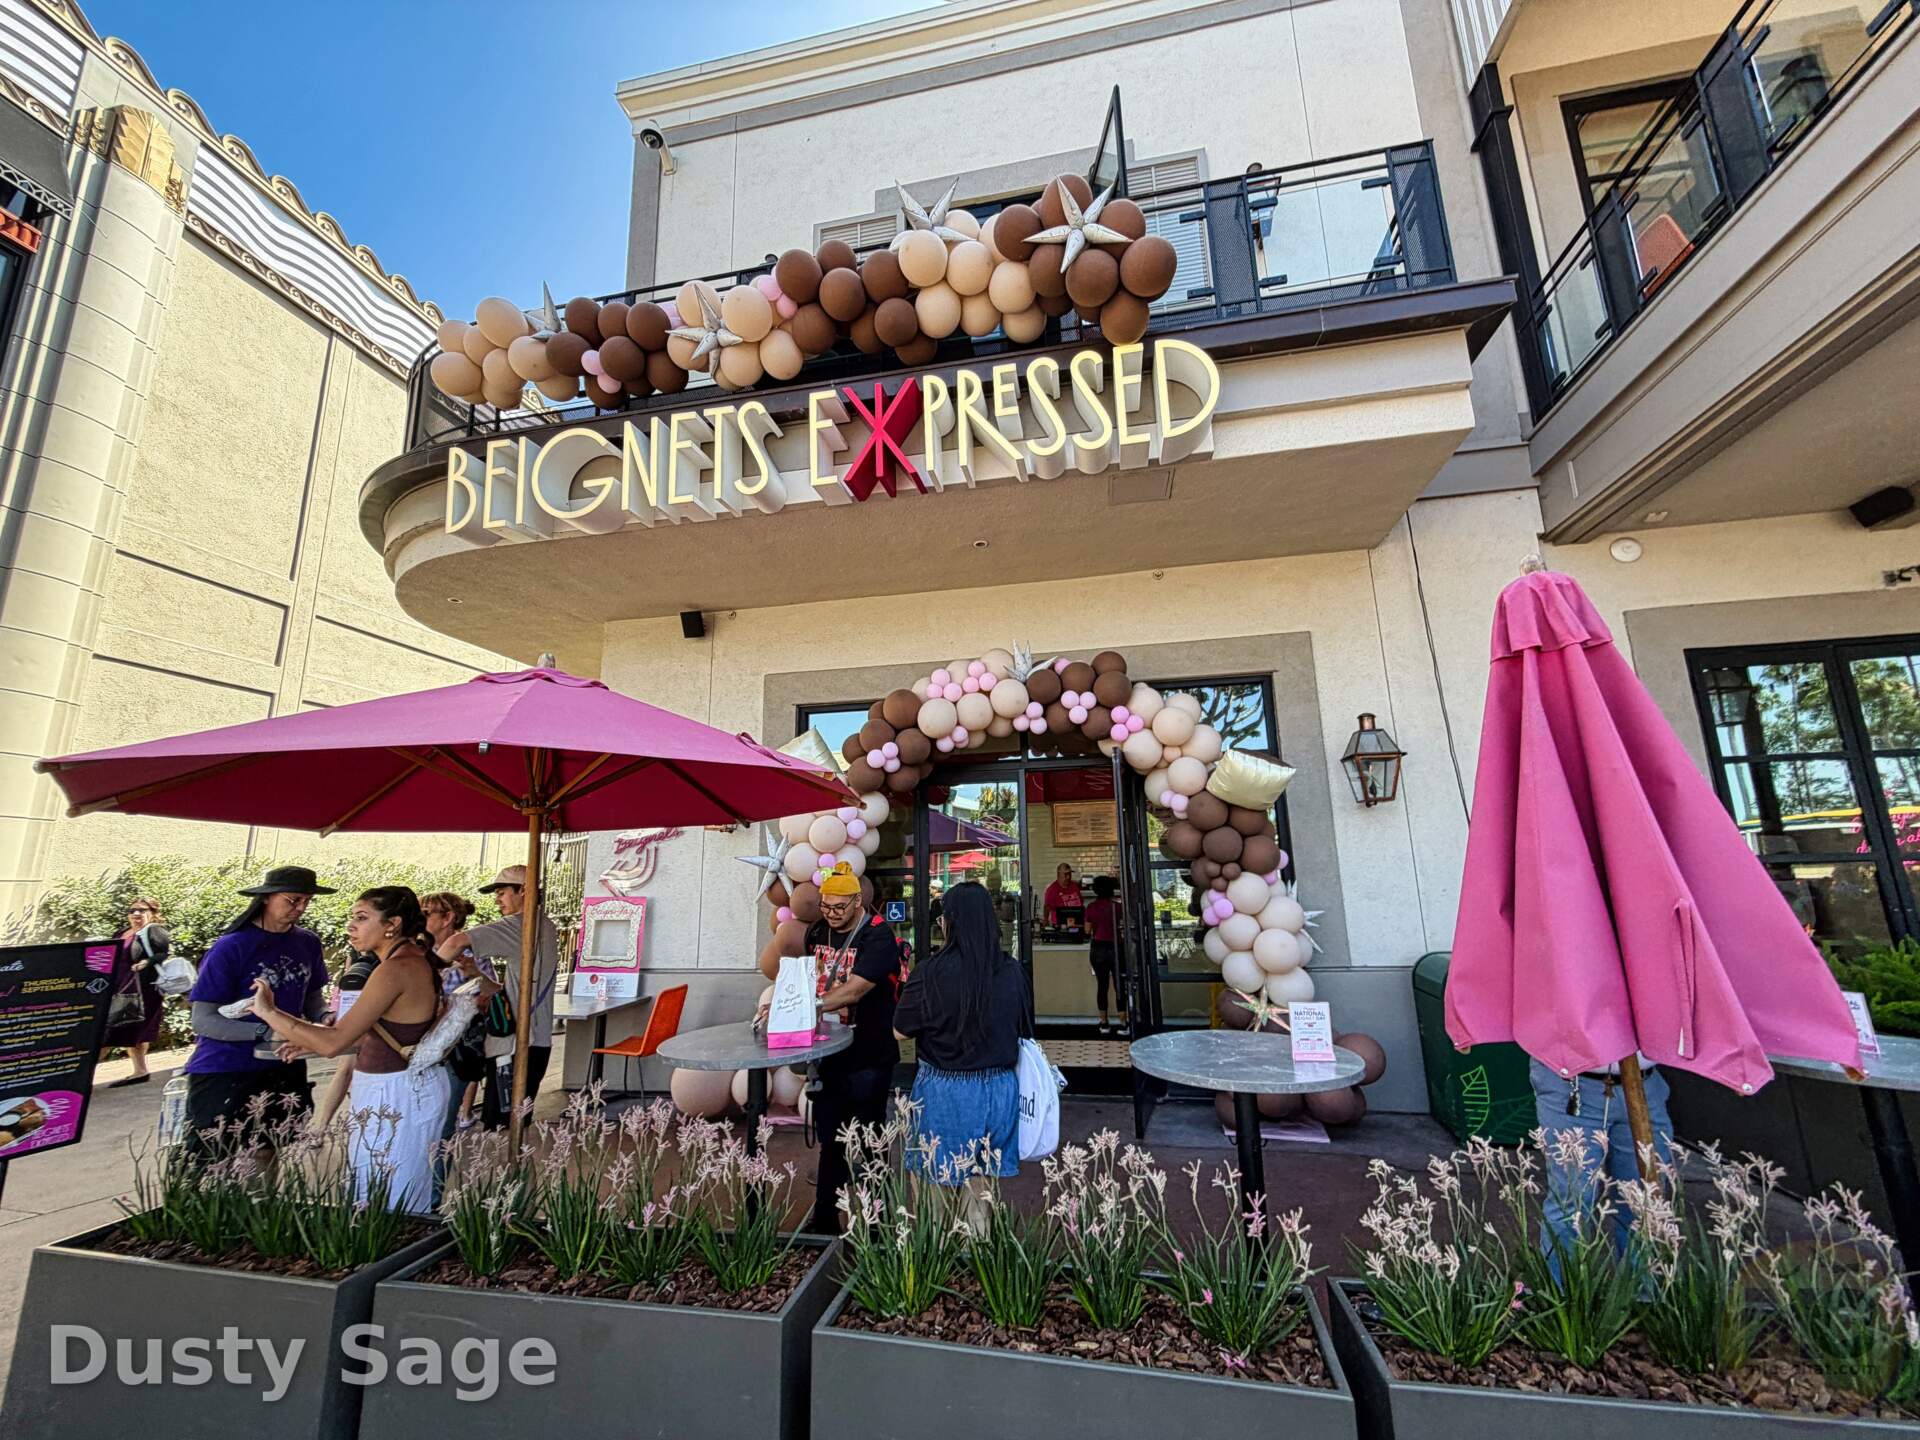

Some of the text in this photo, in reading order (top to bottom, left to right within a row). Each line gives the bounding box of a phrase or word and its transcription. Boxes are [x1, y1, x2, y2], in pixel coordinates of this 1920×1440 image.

[445, 339, 1221, 535] BEIGNETS EXPRESSED
[23, 977, 72, 987] THURSDAY
[21, 983, 75, 994] SEPTEMBER
